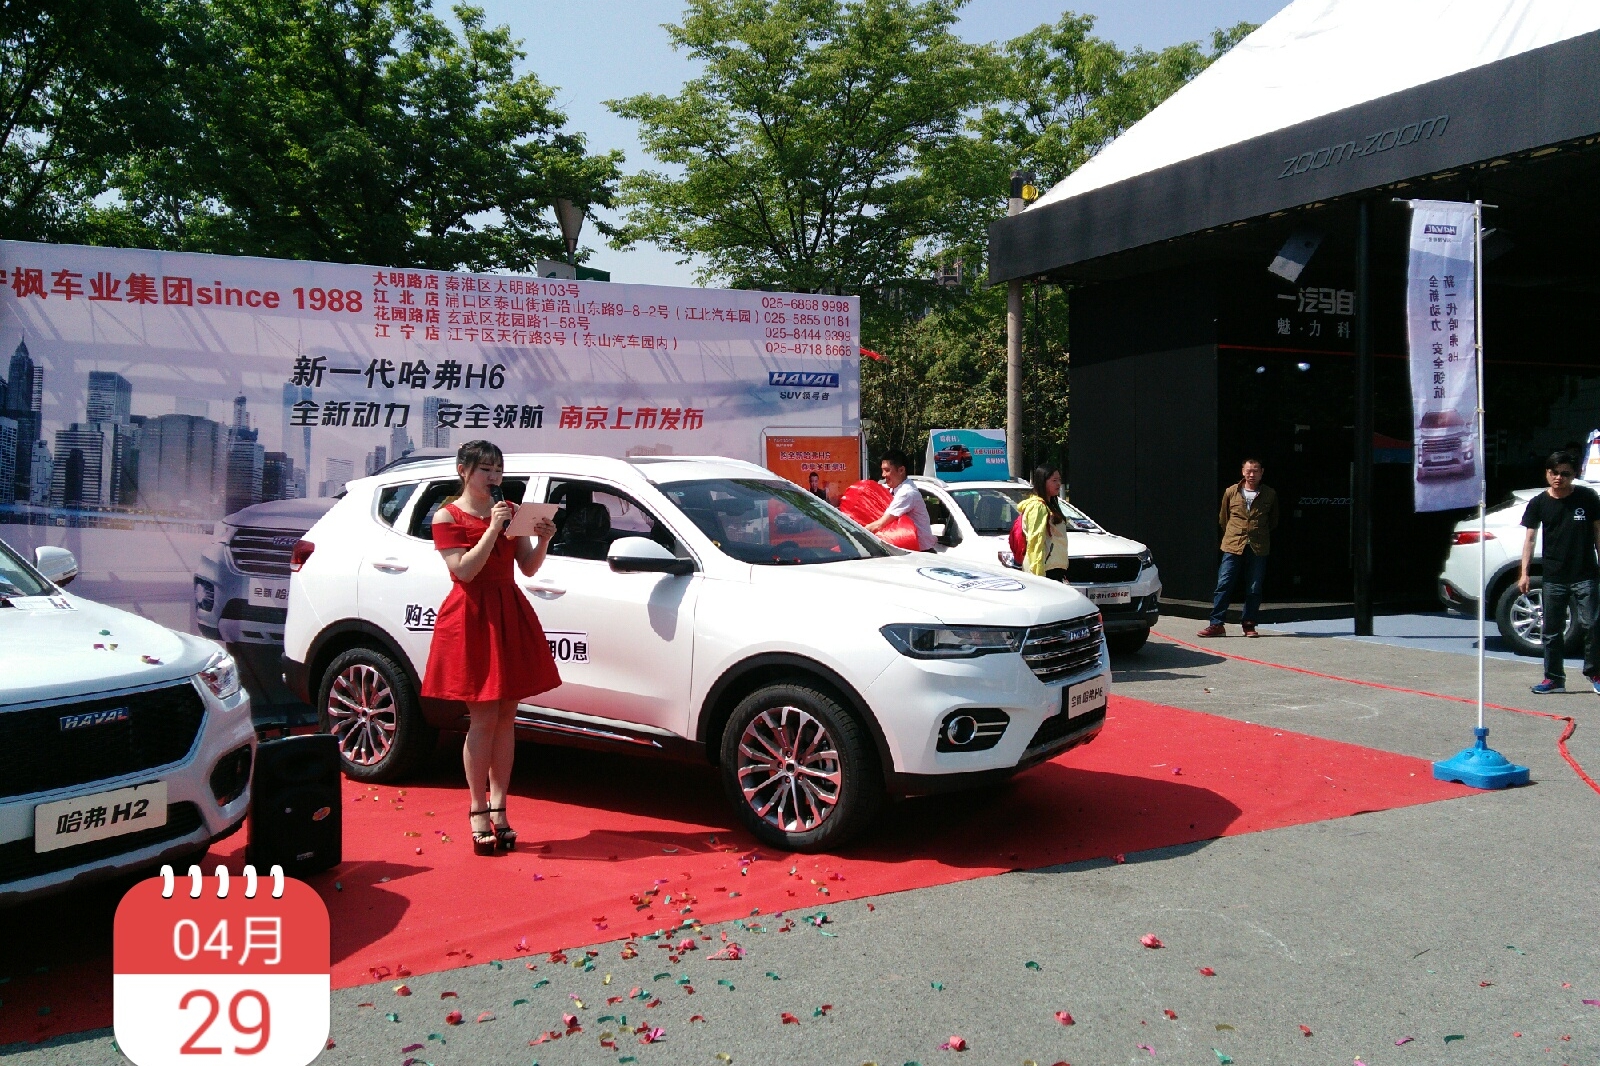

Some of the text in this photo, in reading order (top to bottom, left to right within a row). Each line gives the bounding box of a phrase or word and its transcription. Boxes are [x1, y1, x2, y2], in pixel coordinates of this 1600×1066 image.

[372, 271, 439, 290] 大明路店
[445, 276, 580, 298] 秦淮区大明路103号
[293, 287, 363, 313] 1988
[1277, 287, 1357, 316] 一汽马自
[374, 305, 440, 324] 花园路店
[290, 355, 506, 390] 新一代哈弗H6
[770, 372, 837, 386] HAVAL
[290, 400, 704, 430] 全新动力 安全领航 南京上市发布
[1299, 497, 1351, 505] zoom-zoo
[275, 588, 290, 600] 哈
[63, 707, 128, 729] HAVAL
